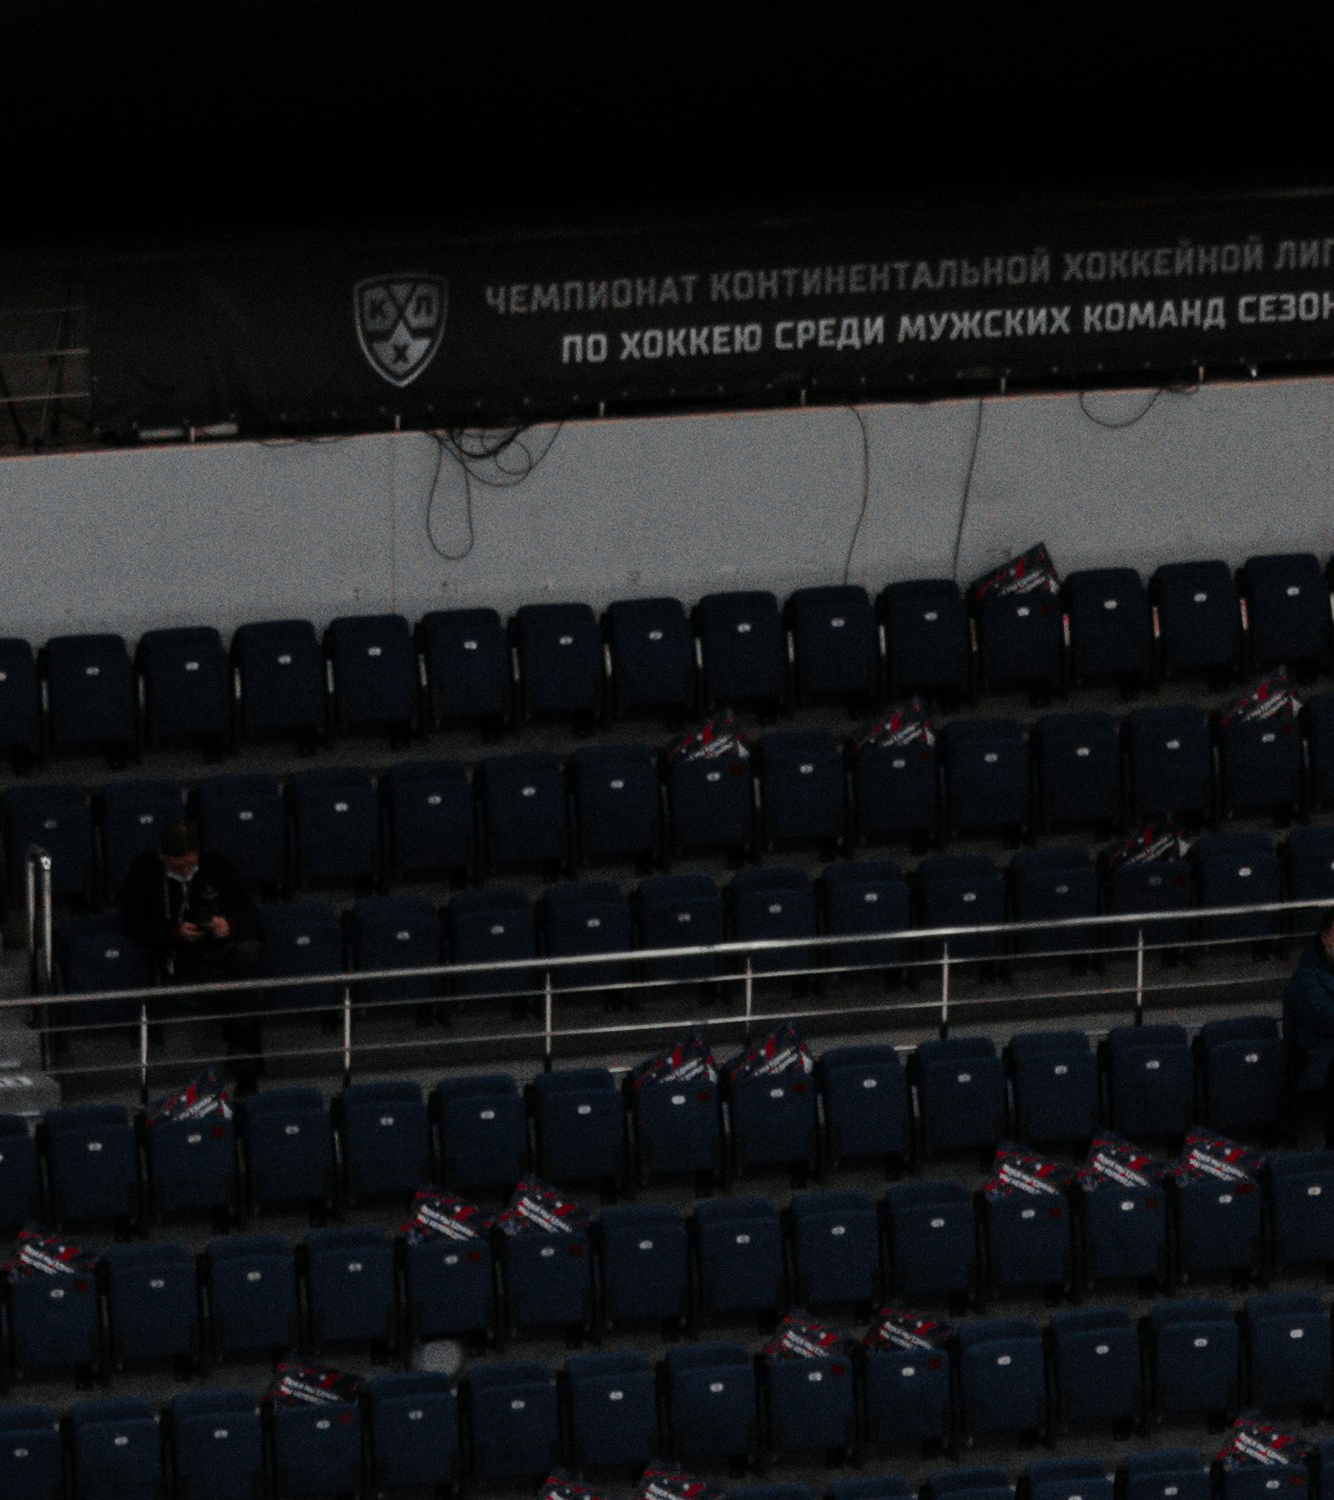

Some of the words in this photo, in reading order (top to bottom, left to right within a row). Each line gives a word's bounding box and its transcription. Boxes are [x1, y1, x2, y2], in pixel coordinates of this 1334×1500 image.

[485, 274, 698, 314] ЧЕМПИОНАТ
[711, 248, 1050, 301] КОНТИНЕНТАЛЬНОЙ
[1063, 235, 1264, 281] ХОККЕЙНОЙ
[563, 334, 607, 364] ПО
[620, 322, 763, 361] ХОККЕЮ
[774, 314, 885, 351] СРЕДИ
[897, 304, 1067, 344] МУЖСКИХ
[1083, 300, 1227, 333] КОМАНД
